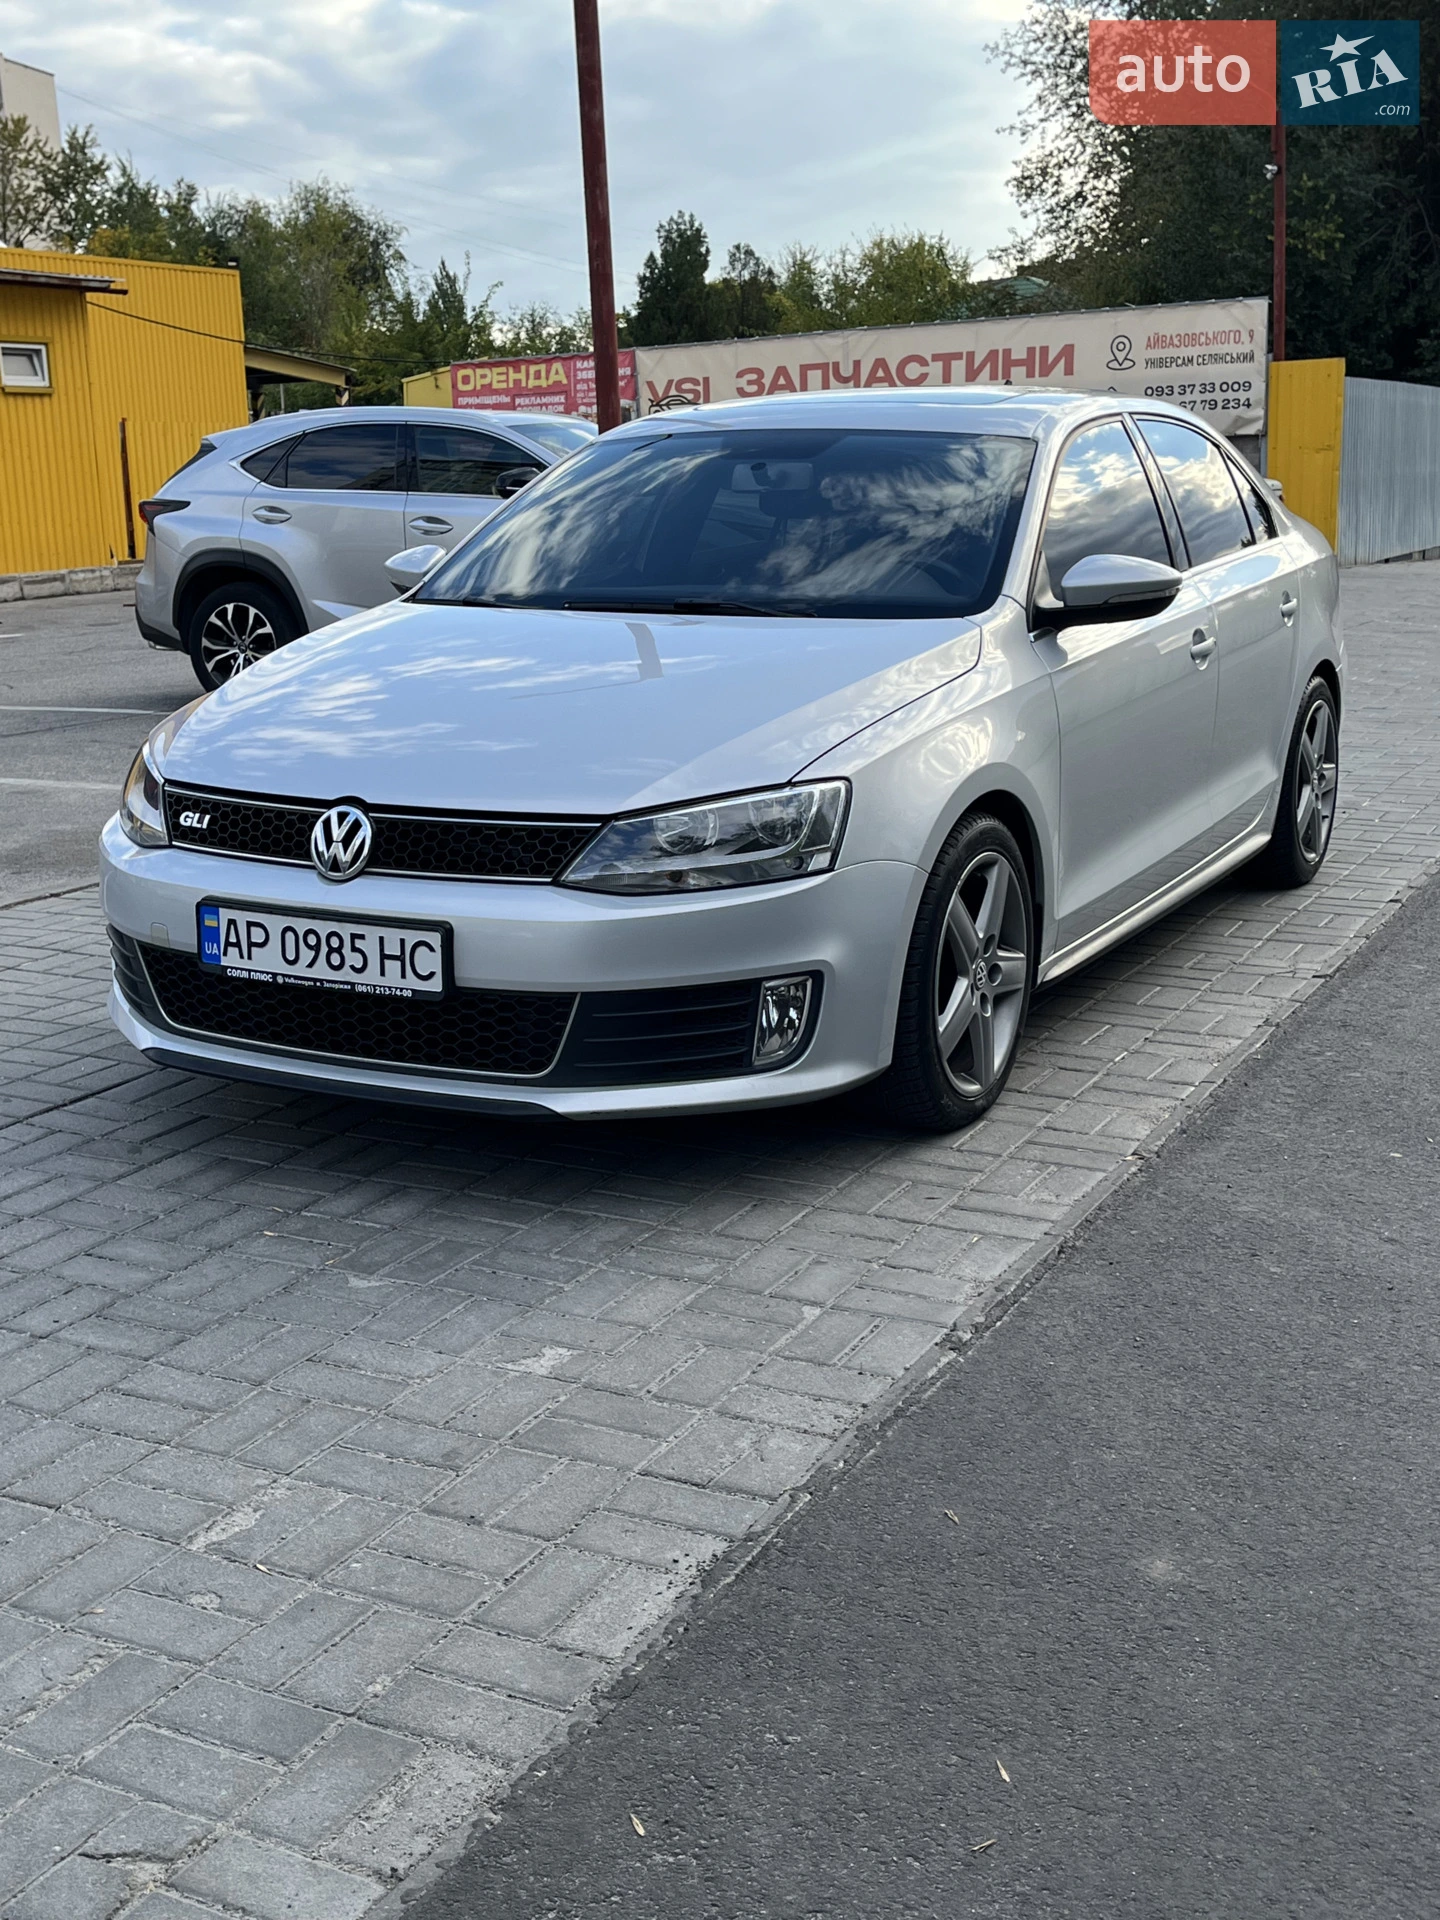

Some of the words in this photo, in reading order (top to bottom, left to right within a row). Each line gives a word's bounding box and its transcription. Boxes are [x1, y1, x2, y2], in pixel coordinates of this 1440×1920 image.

[1248, 329, 1255, 344] 9
[1144, 354, 1194, 369] УНІВЕРСАМ
[1196, 349, 1255, 366] СЕЛЯНСЬКИЙ
[456, 362, 568, 391] ОРЕНДА
[735, 343, 1075, 398] ЗАПЧАСТИНИ
[1144, 385, 1174, 397] 093
[1177, 384, 1196, 396] 37
[1198, 382, 1216, 394] 33
[1219, 381, 1252, 393] 009
[515, 394, 566, 407] РЕКЛАМНИХ
[1200, 399, 1218, 411] 79
[1221, 397, 1252, 410] 234
[179, 811, 211, 829] GLI
[205, 941, 219, 956] UA
[280, 925, 368, 974] 0985
[250, 971, 273, 982] ПЛЮС
[354, 983, 374, 995] (061)
[375, 985, 412, 997] 213-74-00
